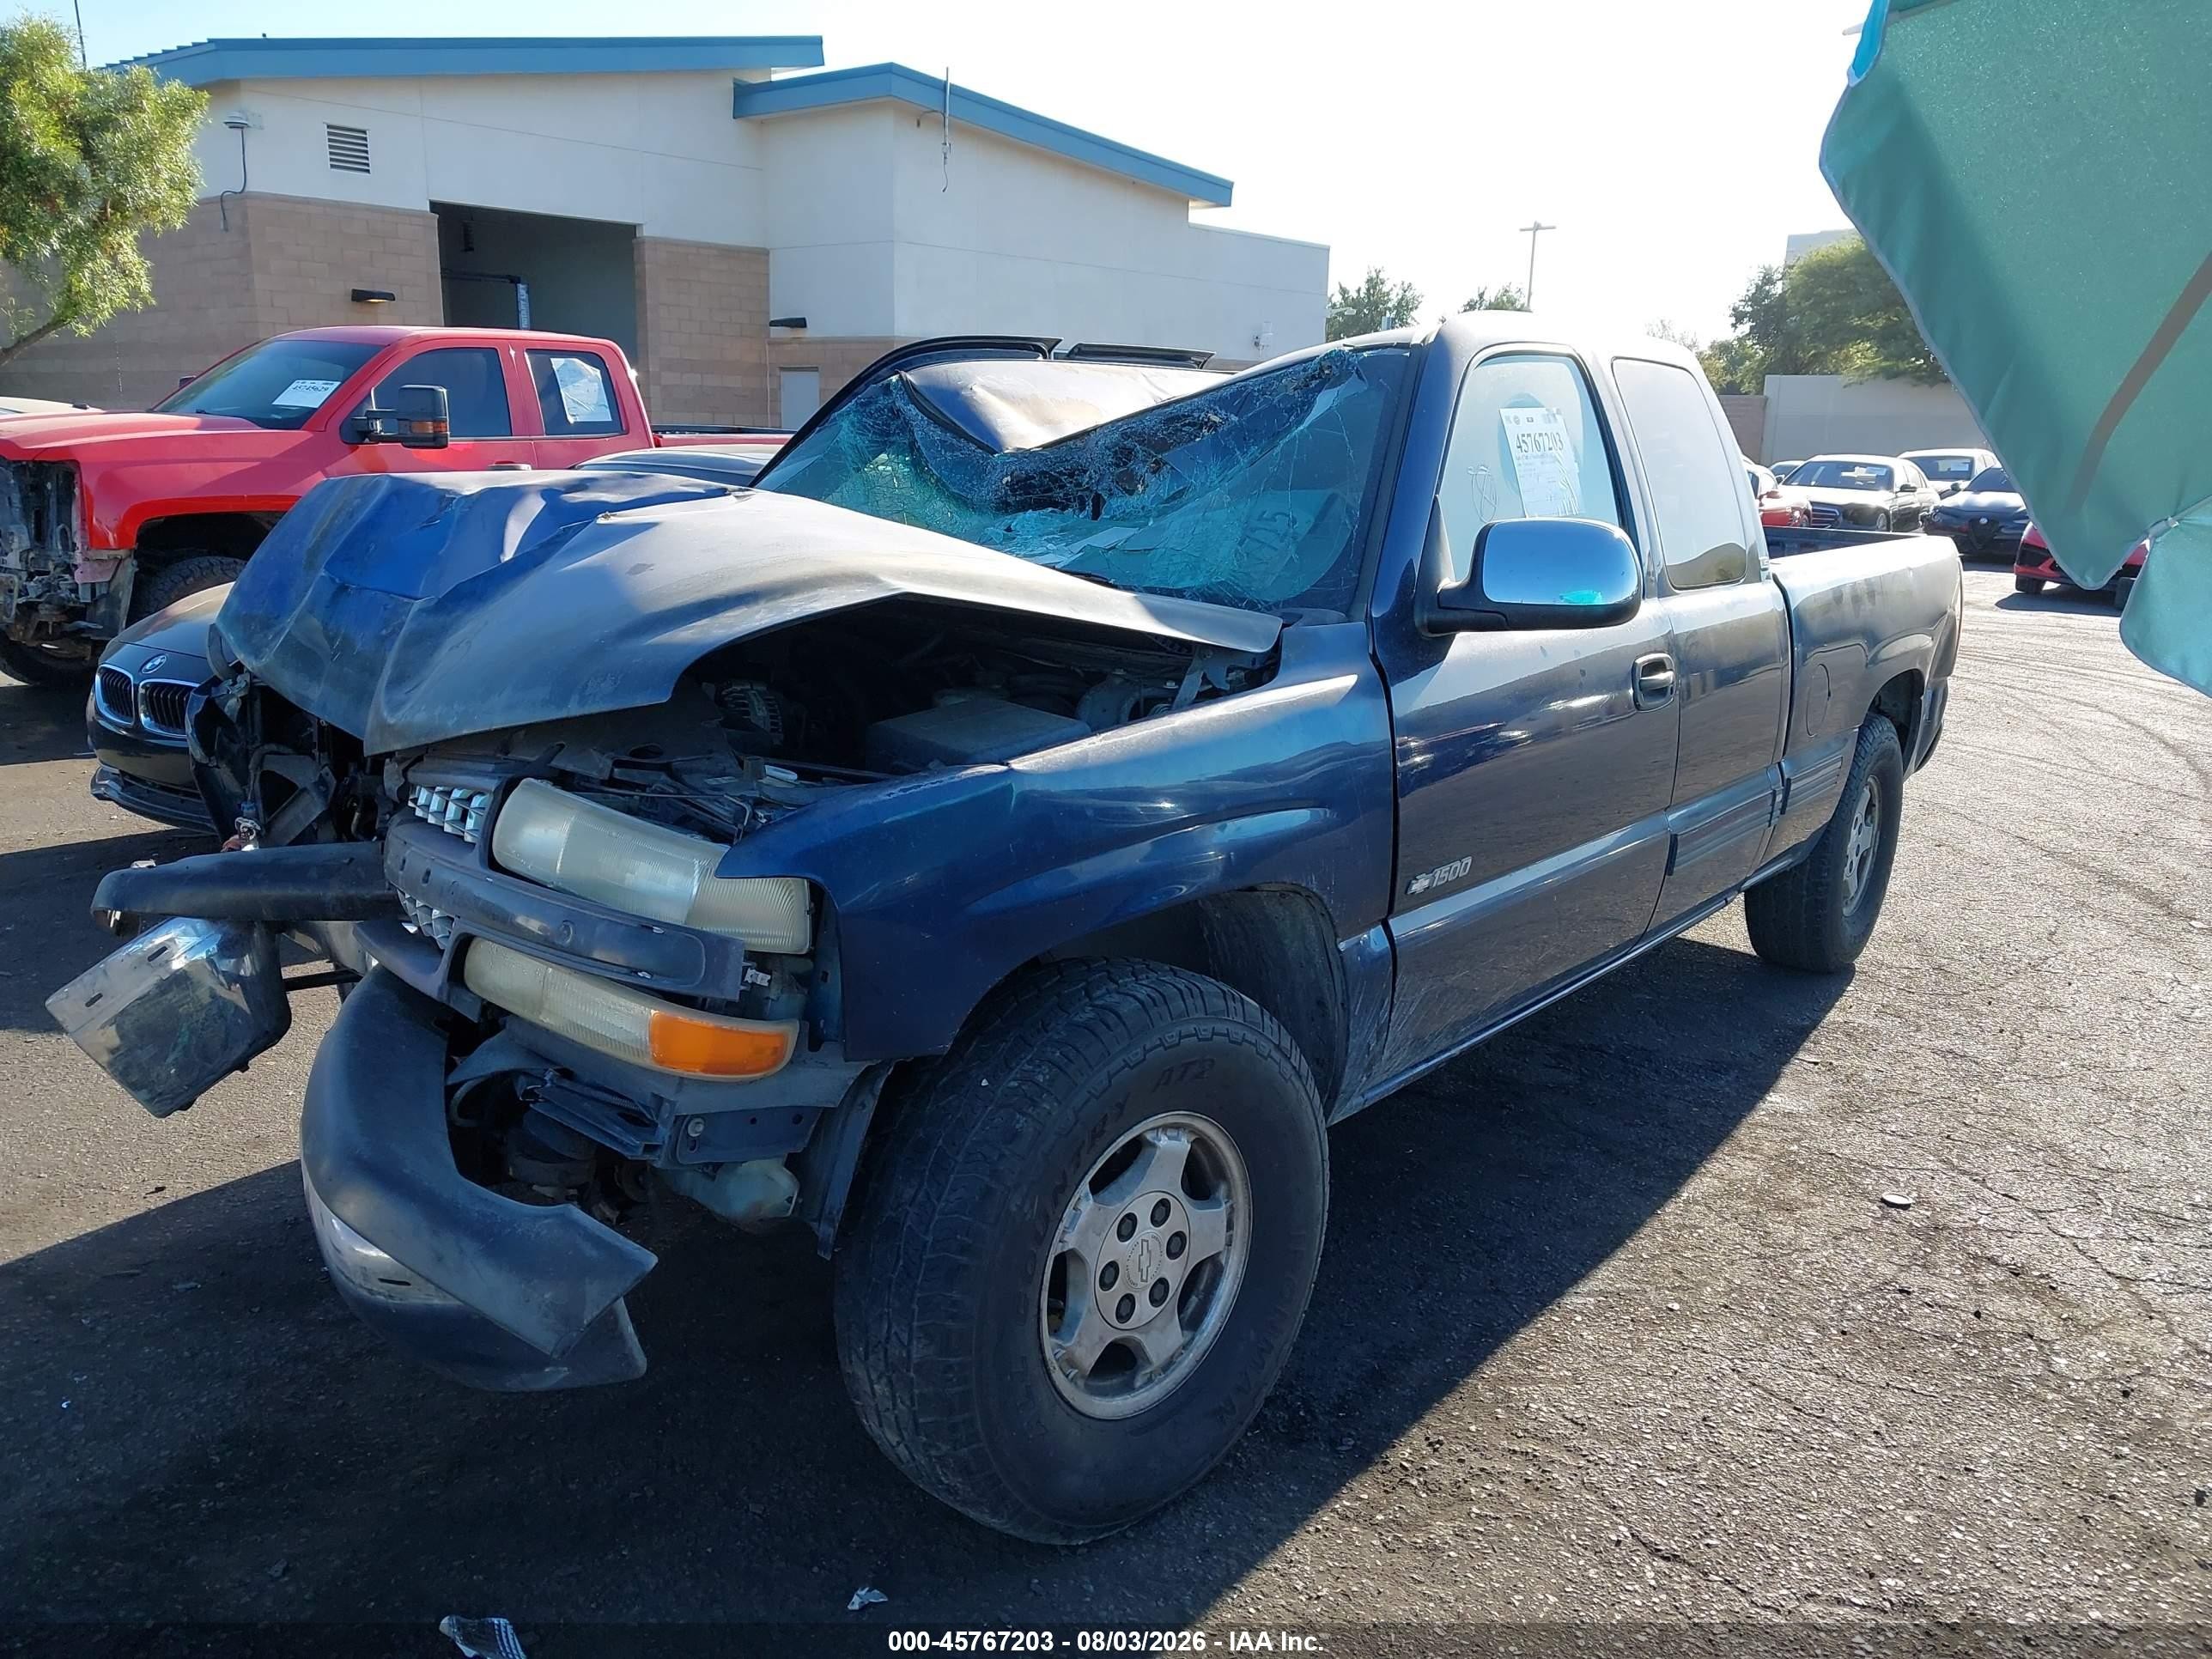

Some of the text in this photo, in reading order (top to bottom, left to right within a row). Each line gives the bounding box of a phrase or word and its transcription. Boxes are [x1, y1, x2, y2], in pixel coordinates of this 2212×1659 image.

[1516, 432, 1564, 453] 45767203
[1432, 856, 1473, 888] 1500
[1154, 1056, 1215, 1092] AT2
